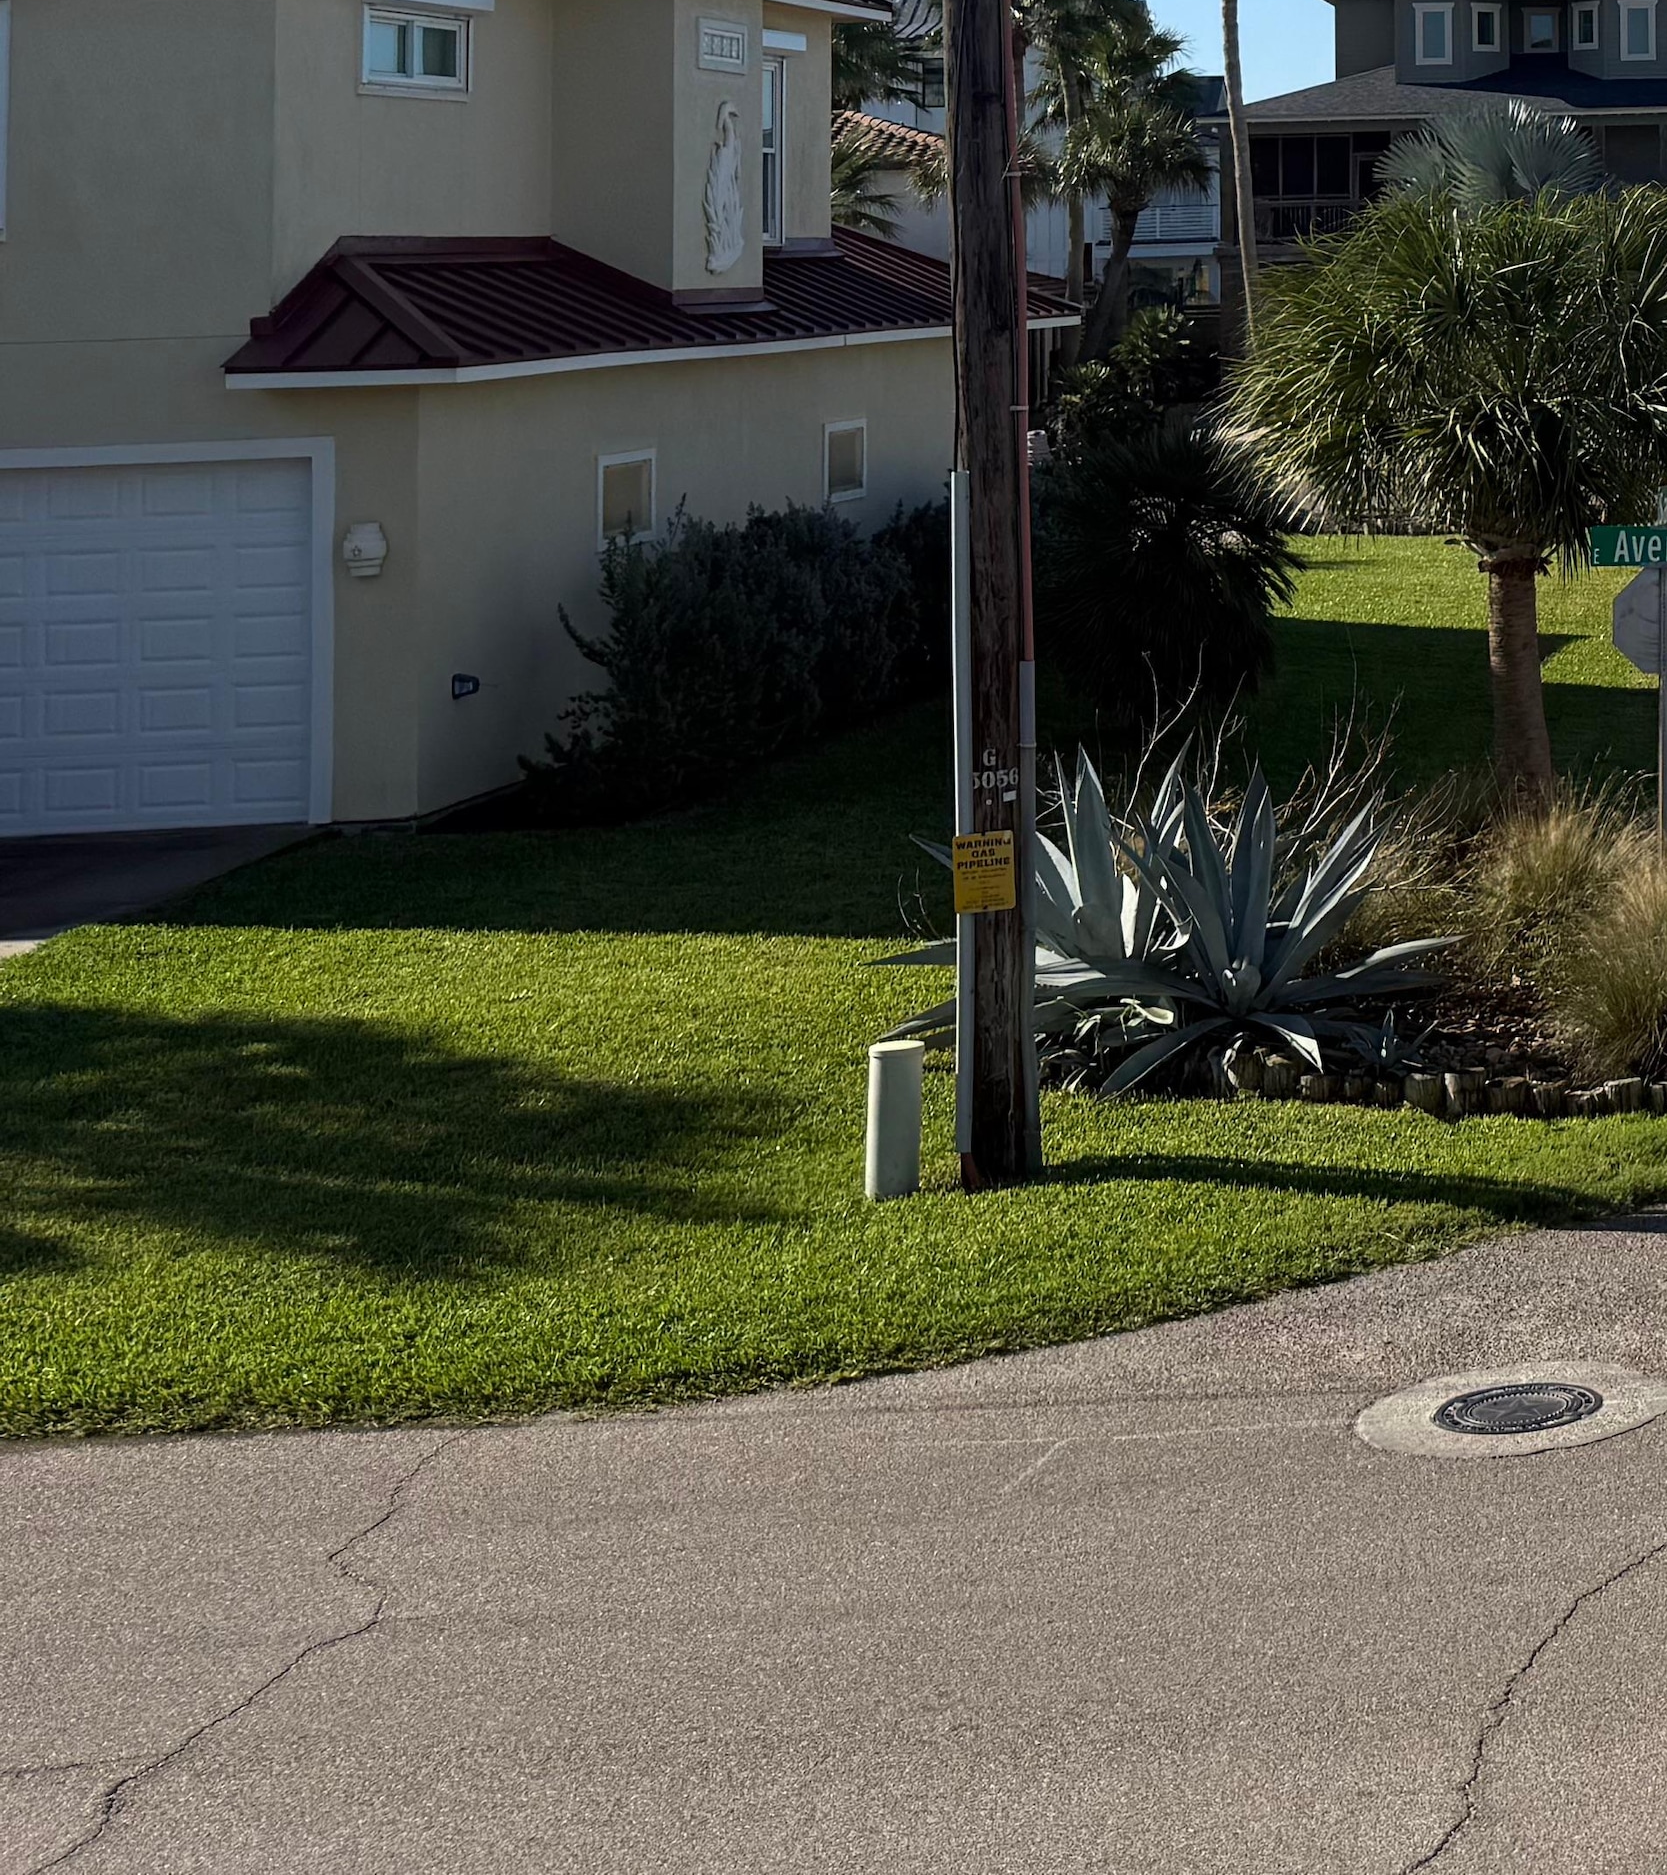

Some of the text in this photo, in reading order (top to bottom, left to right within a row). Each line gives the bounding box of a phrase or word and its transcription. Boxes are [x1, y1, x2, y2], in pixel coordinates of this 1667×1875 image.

[1593, 548, 1600, 565] E
[982, 748, 996, 766] G
[955, 837, 1011, 850] WARNING
[972, 848, 996, 858] GAS
[956, 856, 1011, 870] PIPELINE
